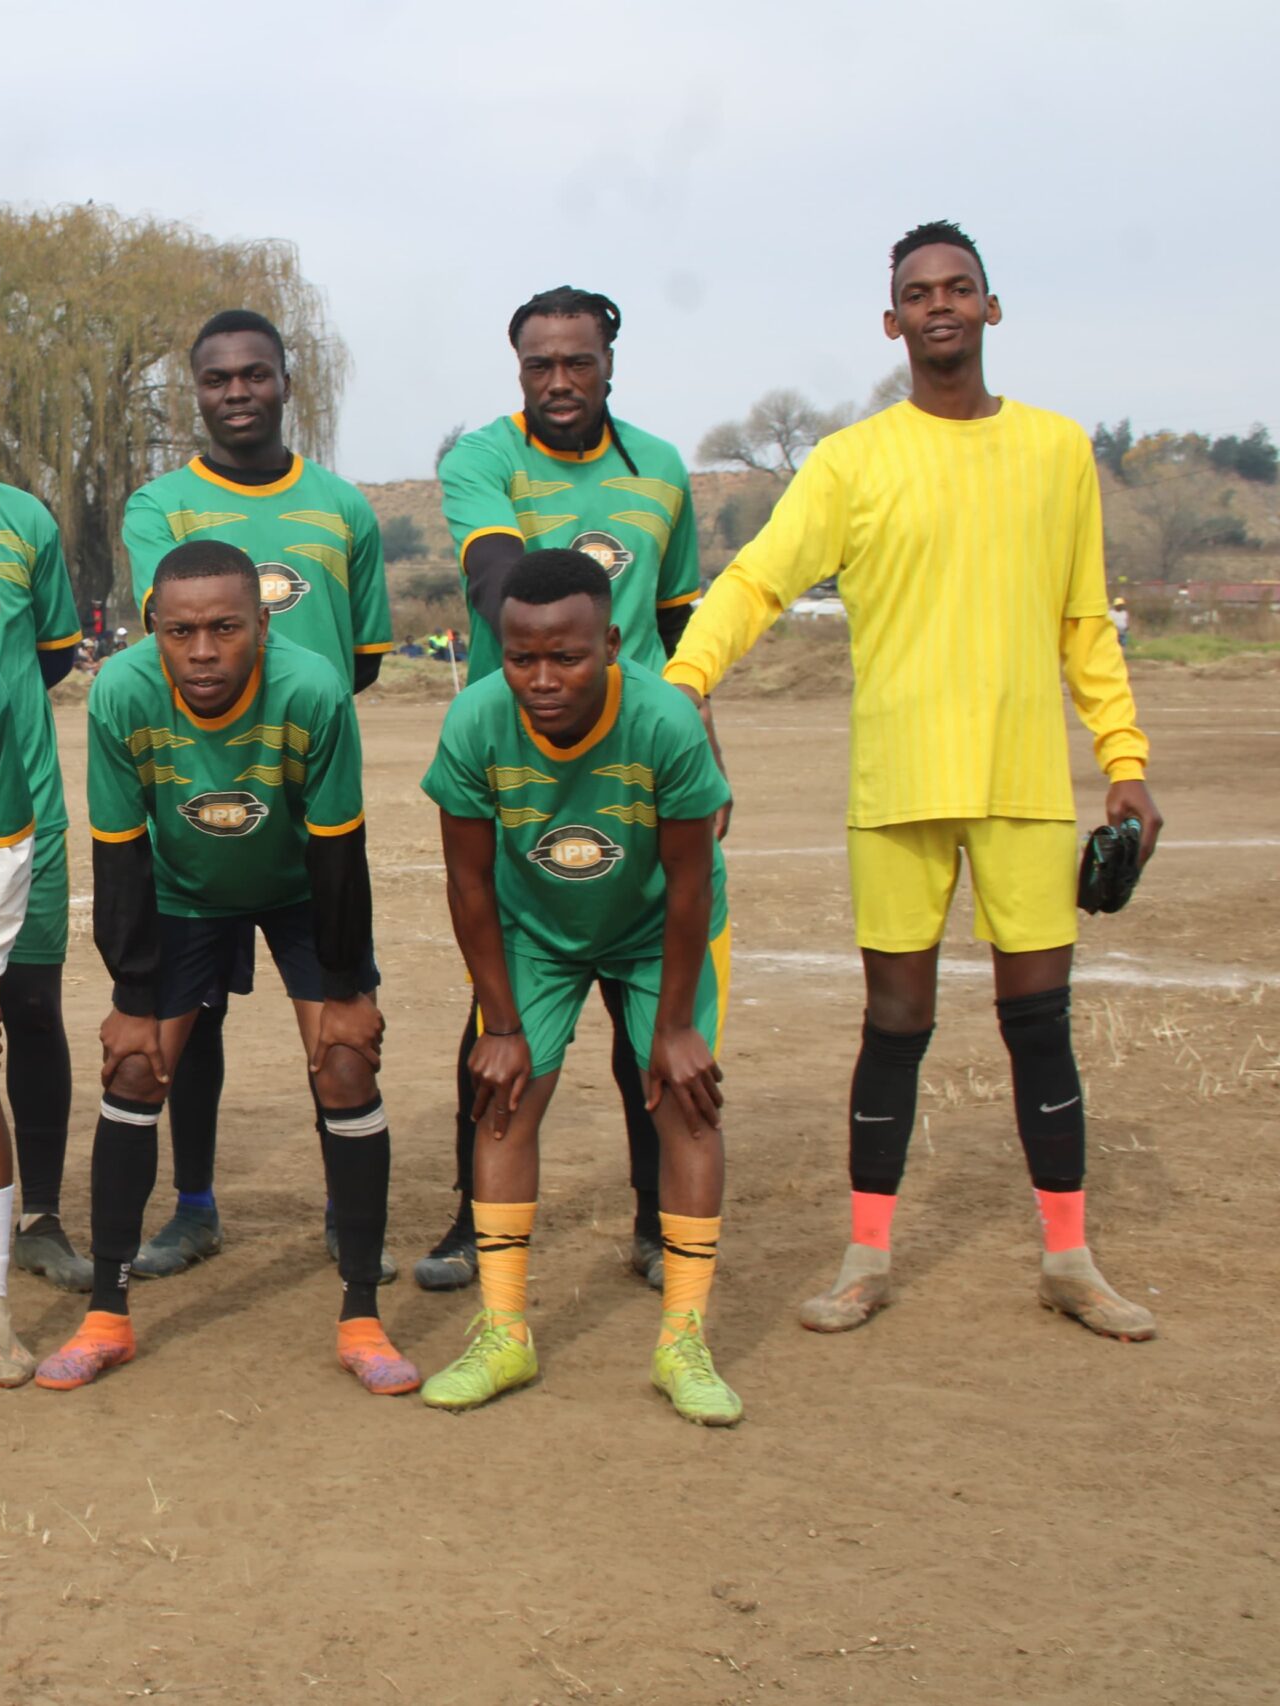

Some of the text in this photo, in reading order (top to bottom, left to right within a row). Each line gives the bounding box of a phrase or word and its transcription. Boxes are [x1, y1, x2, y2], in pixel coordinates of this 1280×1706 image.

[580, 549, 612, 566] PP
[262, 579, 289, 597] PP
[204, 807, 244, 824] IPP
[555, 844, 597, 862] IPP
